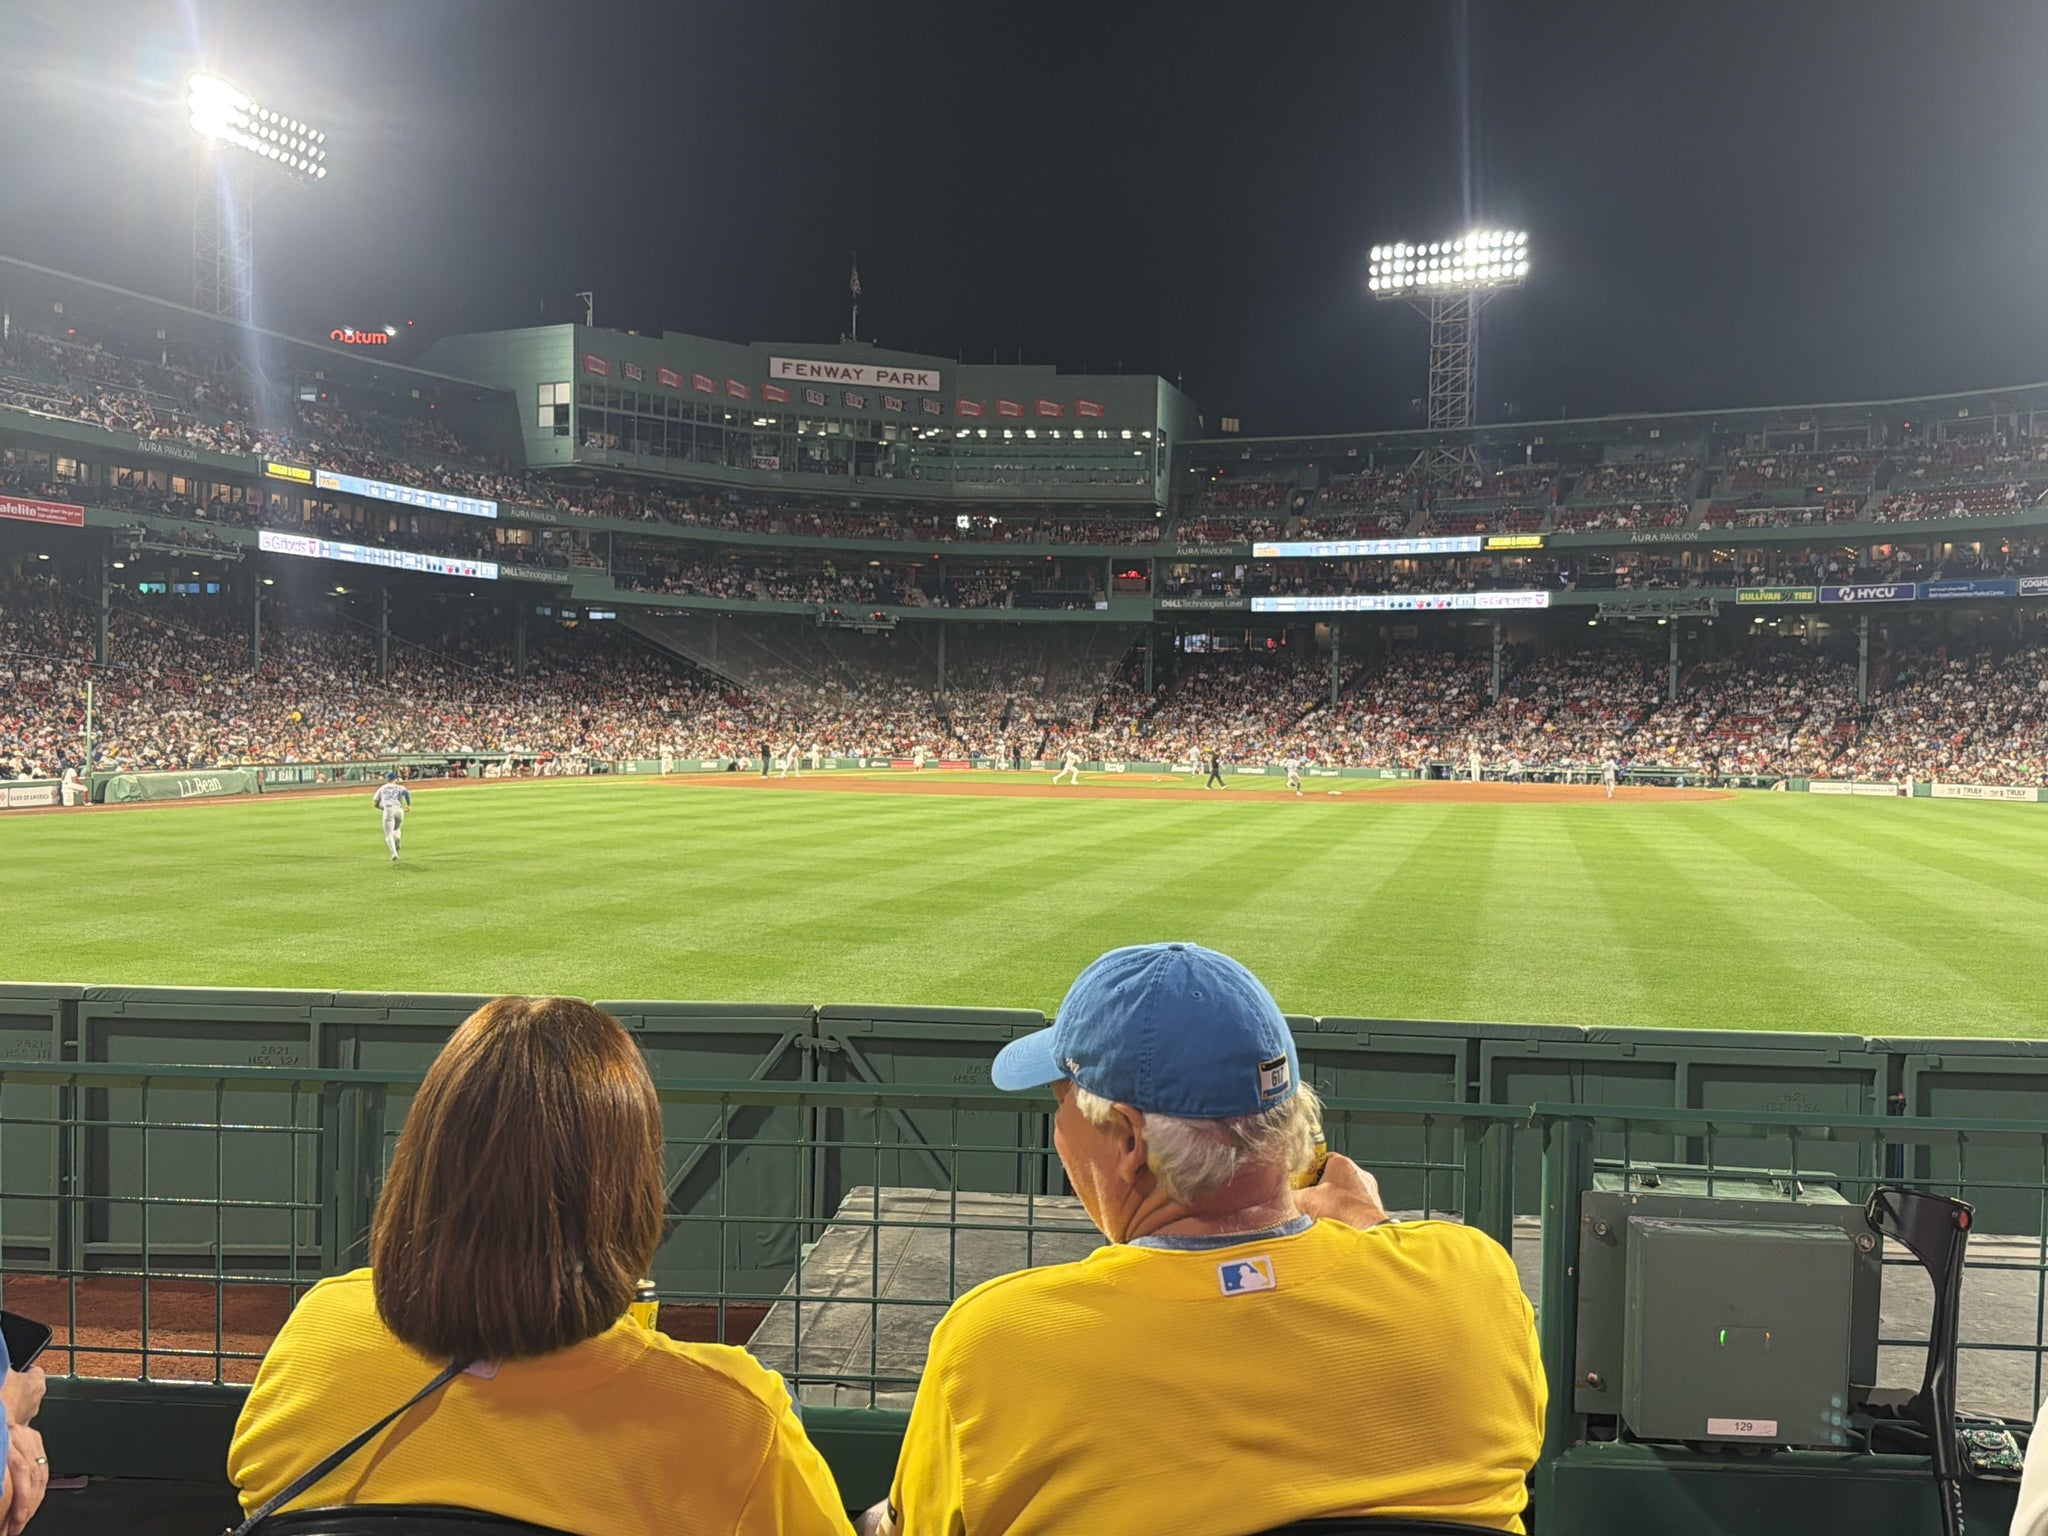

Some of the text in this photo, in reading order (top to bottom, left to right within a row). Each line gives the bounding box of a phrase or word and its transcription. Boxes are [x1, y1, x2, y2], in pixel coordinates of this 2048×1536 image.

[330, 329, 389, 344] Optum
[782, 362, 929, 386] FENWAY PARK
[164, 446, 197, 460] PAVILION
[1660, 532, 1698, 541] PAVILION
[1200, 547, 1232, 555] PAVILION
[1739, 590, 1813, 601] SULLIVAN TIRE
[1857, 587, 1896, 599] HYCU
[1161, 600, 1182, 608] DELL
[1182, 599, 1225, 609] Technologies
[1225, 599, 1243, 607] Level
[1963, 787, 1982, 795] TRULY
[1271, 1067, 1284, 1087] 617
[1735, 1421, 1753, 1432] 129
